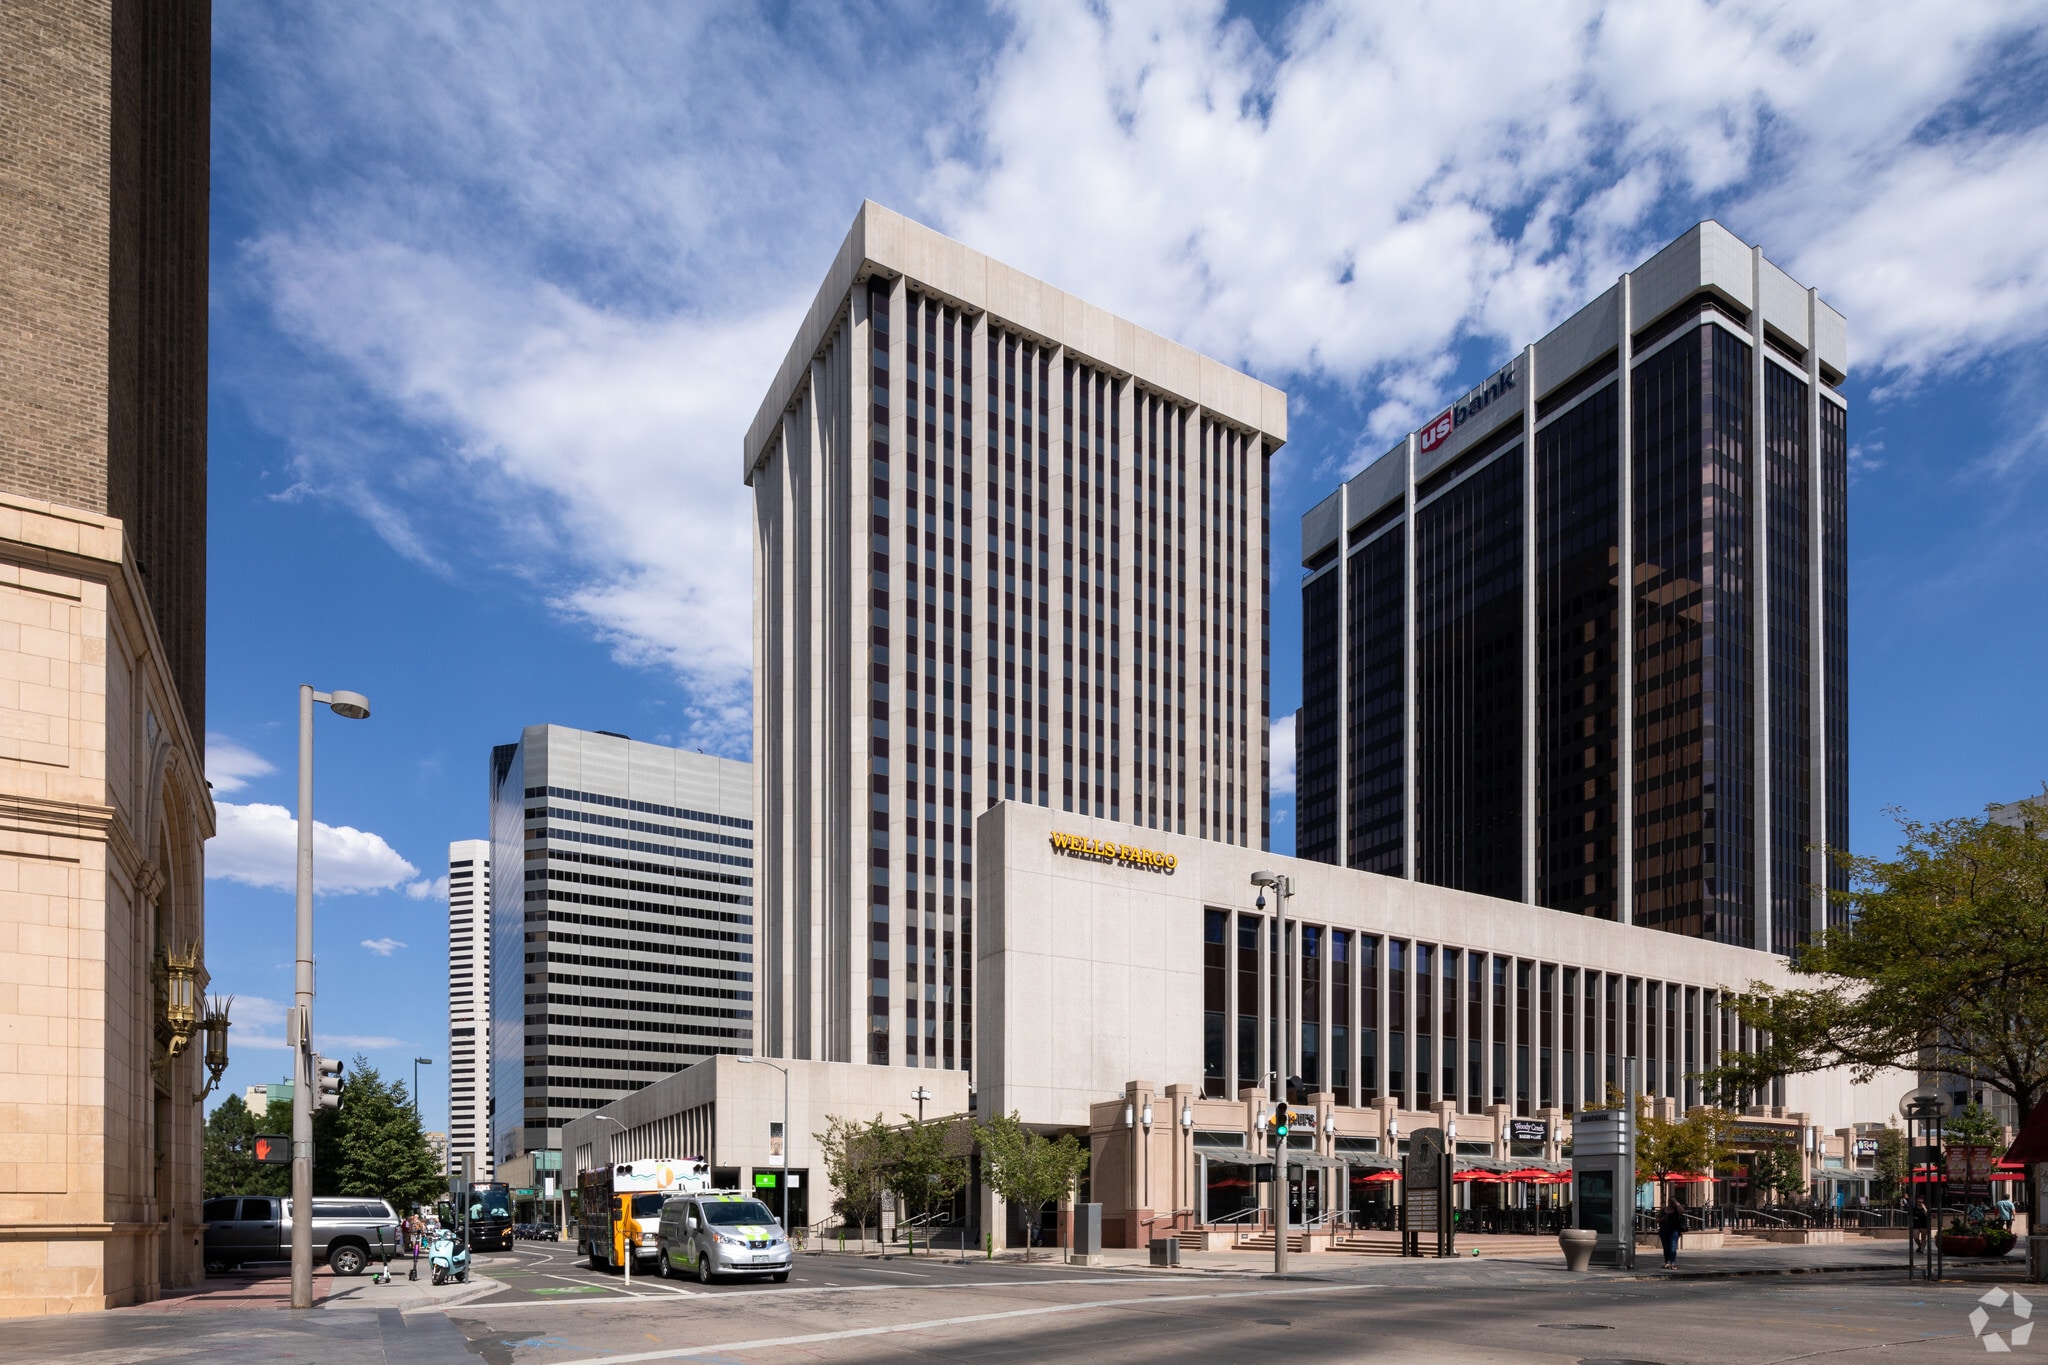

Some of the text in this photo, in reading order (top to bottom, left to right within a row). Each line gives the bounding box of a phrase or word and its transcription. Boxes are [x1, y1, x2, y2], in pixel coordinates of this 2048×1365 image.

[1453, 369, 1516, 429] bank
[1050, 831, 1178, 869] WELLS FARGO
